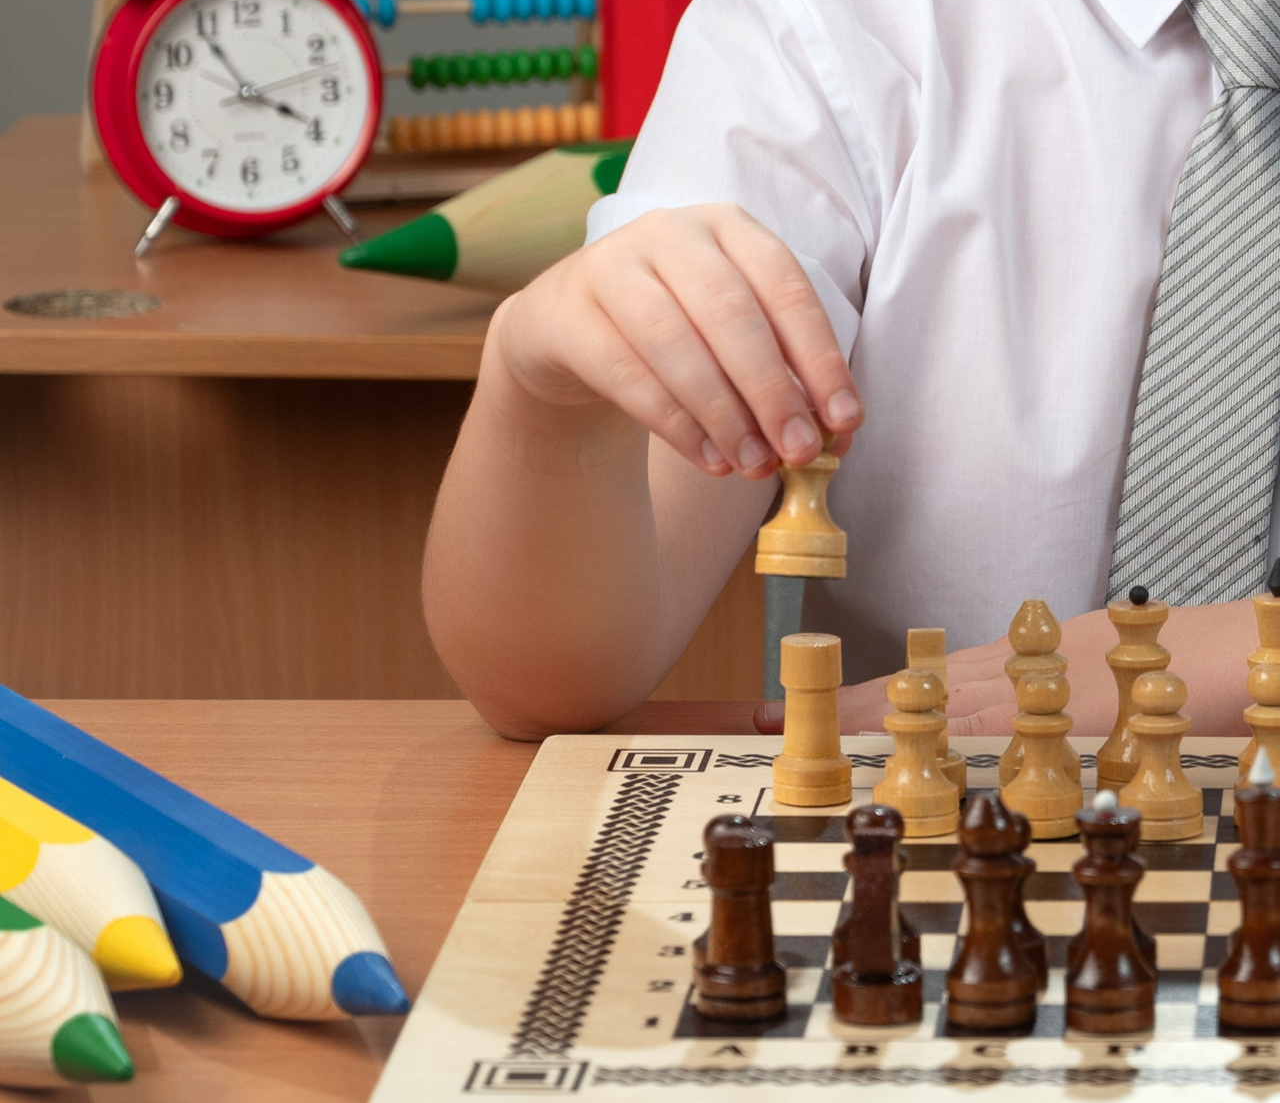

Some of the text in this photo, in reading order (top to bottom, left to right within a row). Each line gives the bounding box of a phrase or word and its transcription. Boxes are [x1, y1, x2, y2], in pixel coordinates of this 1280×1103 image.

[196, 9, 220, 36] 11
[232, 0, 262, 28] 12
[281, 9, 293, 37] 1
[165, 40, 192, 69] 10
[308, 34, 325, 64] 2
[153, 80, 174, 113] 9
[321, 77, 340, 106] 3
[169, 119, 191, 153] 8
[304, 116, 325, 144] 4
[201, 148, 220, 178] 7
[241, 157, 260, 187] 6
[282, 144, 299, 175] 5
[716, 793, 742, 804] 8
[667, 912, 695, 923] 4
[656, 945, 685, 957] 3
[646, 979, 675, 994] 2
[710, 1043, 746, 1057] A
